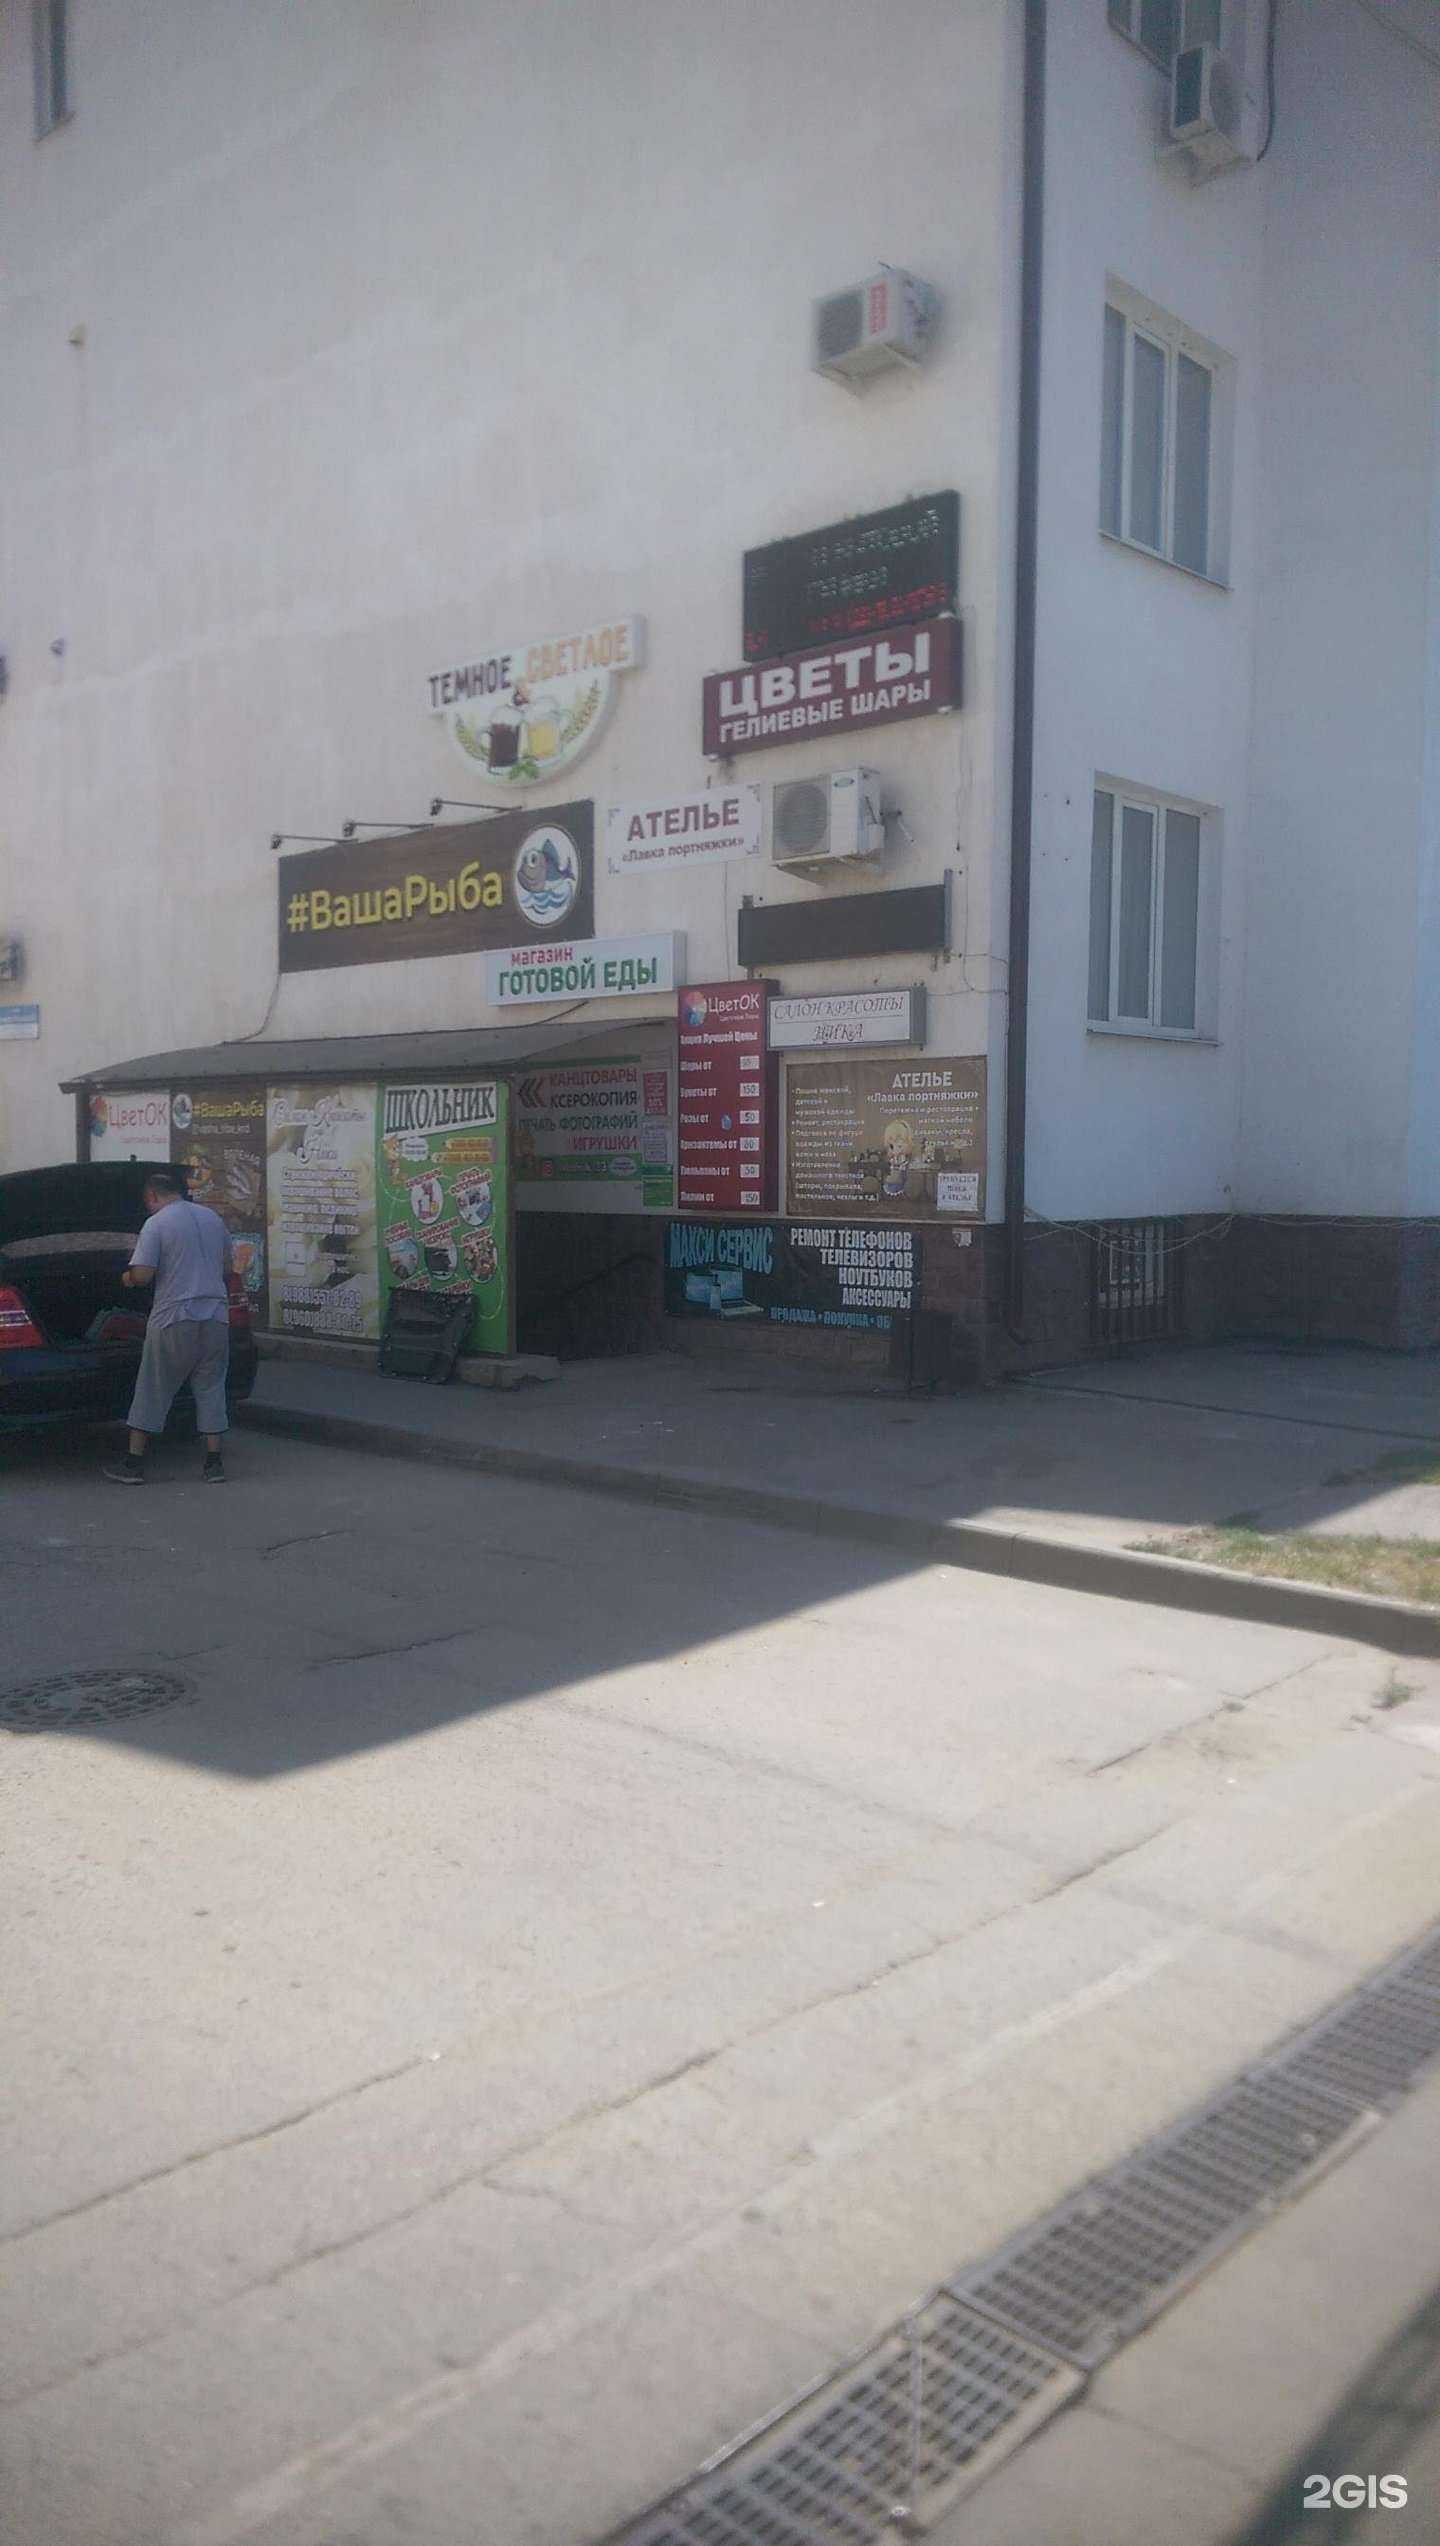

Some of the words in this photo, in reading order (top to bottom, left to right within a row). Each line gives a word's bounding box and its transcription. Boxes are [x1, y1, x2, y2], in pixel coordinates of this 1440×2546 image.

[428, 654, 513, 708] ТЕМНОЕ
[719, 633, 931, 716] ЦВЕТЫ
[719, 698, 844, 743] ГЕЛИЕВЫЕ
[851, 679, 931, 716] ШАРЫ
[626, 798, 740, 842] АТЕЛЬЕ
[287, 860, 504, 933] #ВашаРыба
[511, 947, 574, 966] магазин
[499, 955, 596, 996] ГОТОВОЙ
[603, 956, 657, 991] ЕДЫ
[708, 991, 760, 1016] ЦветОК
[550, 1068, 638, 1087] КАНЦТОВАРЫ
[892, 1071, 953, 1089] АТЕЛЬЕ
[385, 1086, 495, 1134] ШКОЛЬНИК
[550, 1090, 638, 1109] КСЕРОКОПИЯ
[108, 1101, 167, 1130] ЦветОК
[559, 1110, 638, 1131] ФОТОГРАФИЙ
[573, 1136, 638, 1151] ИГРУШКИ
[670, 1222, 715, 1269] МАКСИ
[718, 1225, 773, 1275] СЕРВИС
[790, 1227, 836, 1248] РЕМОНТ
[837, 1228, 912, 1250] ТЕЛЕФОНОВ
[820, 1248, 913, 1269] ТЕЛЕВИЗОРОВ
[838, 1267, 913, 1289] НОУТБУКОВ
[842, 1286, 912, 1310] АКСЕССУАРЫ
